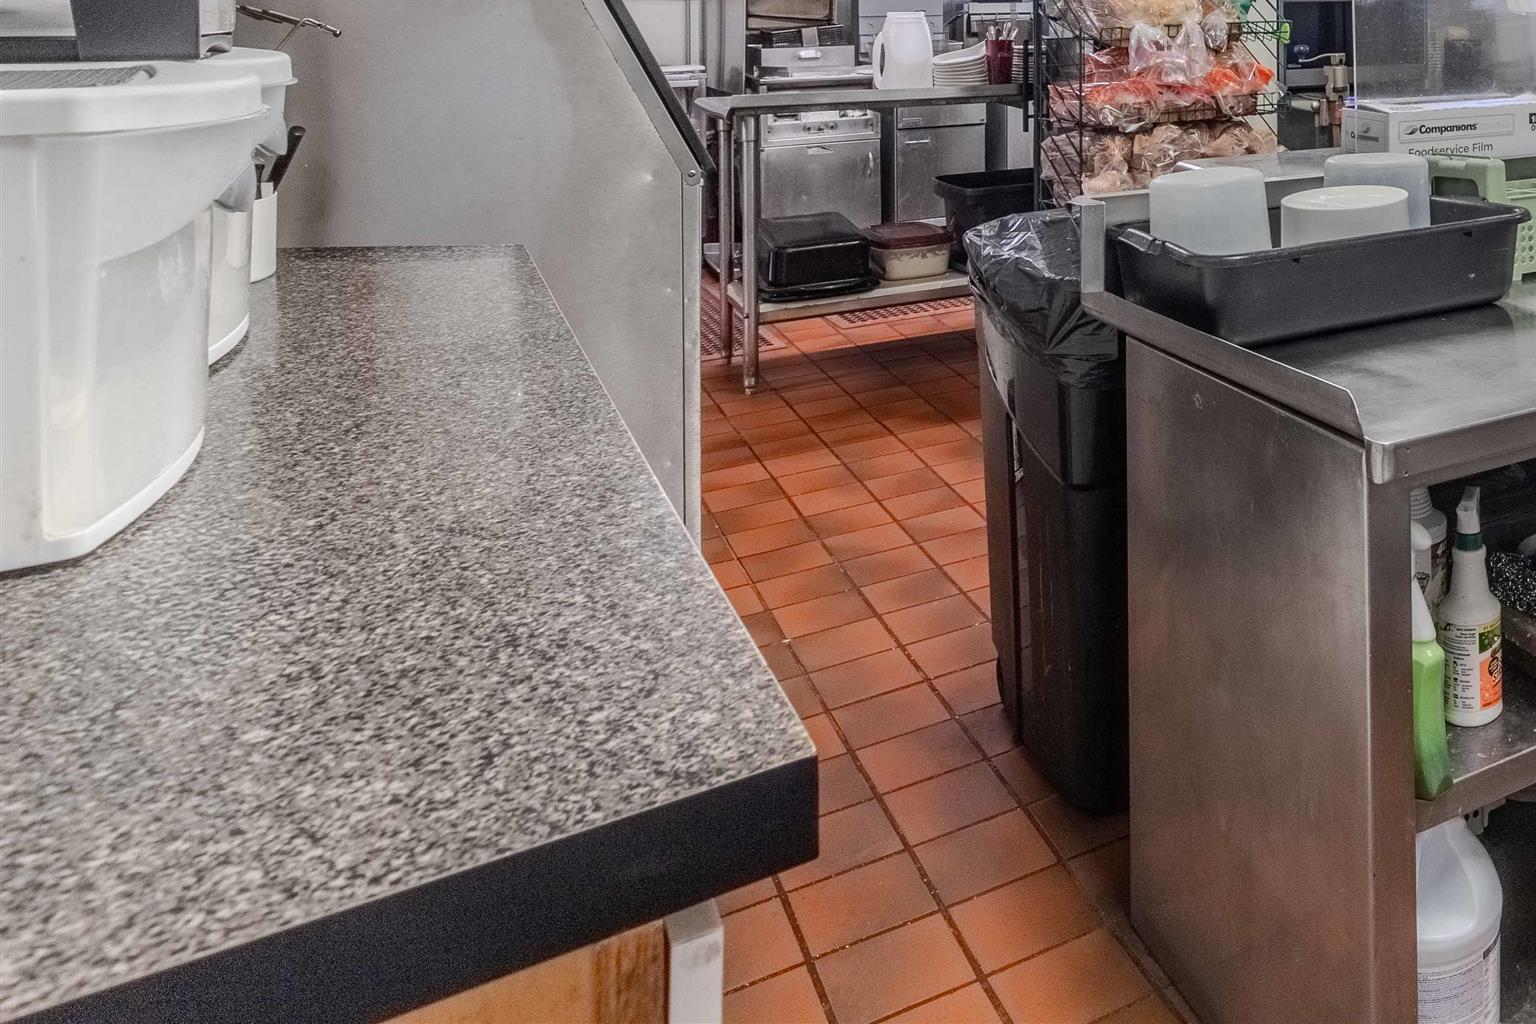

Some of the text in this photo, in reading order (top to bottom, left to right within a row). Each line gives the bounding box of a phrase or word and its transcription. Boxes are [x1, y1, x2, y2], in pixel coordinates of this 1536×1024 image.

[1418, 123, 1477, 136] Companions
[1408, 142, 1493, 156] Foodservice Film
